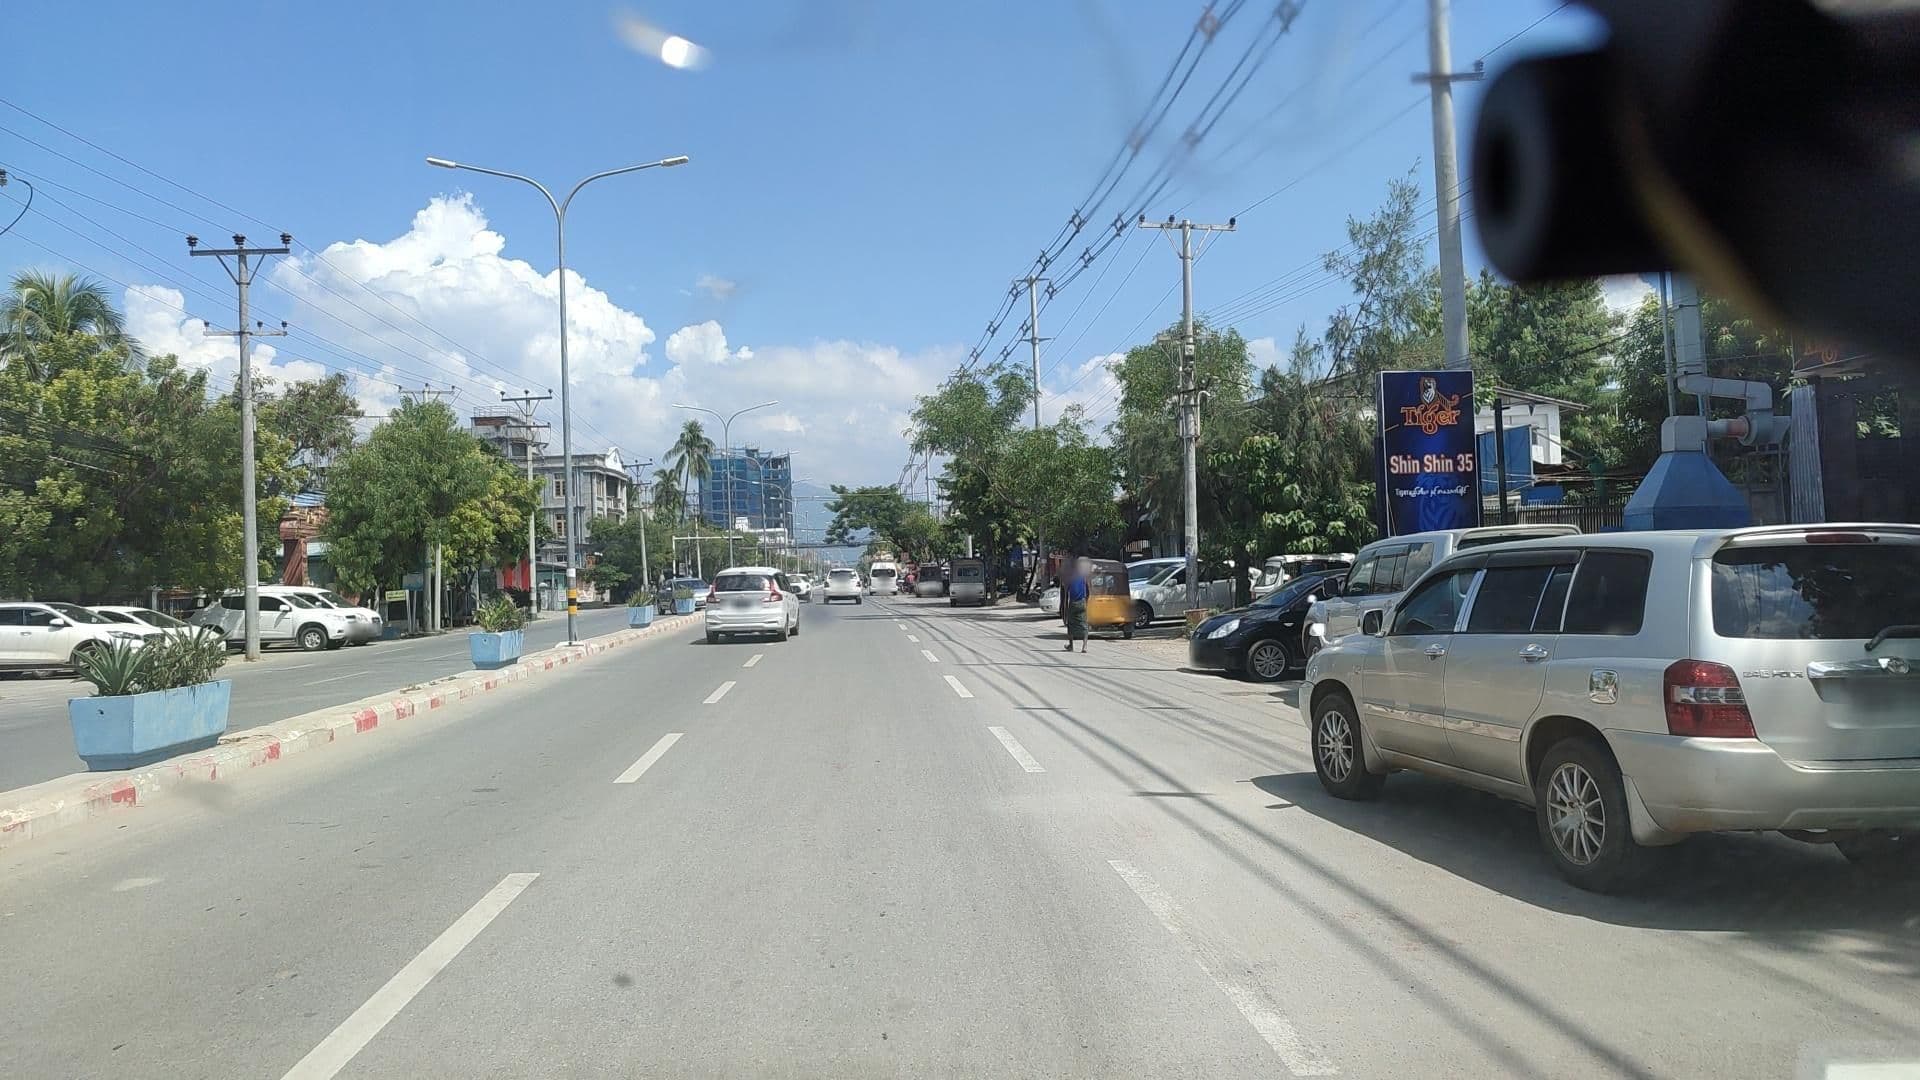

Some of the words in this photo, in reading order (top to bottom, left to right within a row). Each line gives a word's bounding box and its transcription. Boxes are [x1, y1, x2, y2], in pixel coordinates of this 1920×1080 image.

[1401, 405, 1460, 434] Tiger
[1390, 455, 1420, 474] Shin
[1424, 454, 1453, 473] Shin
[1457, 453, 1473, 472] 35
